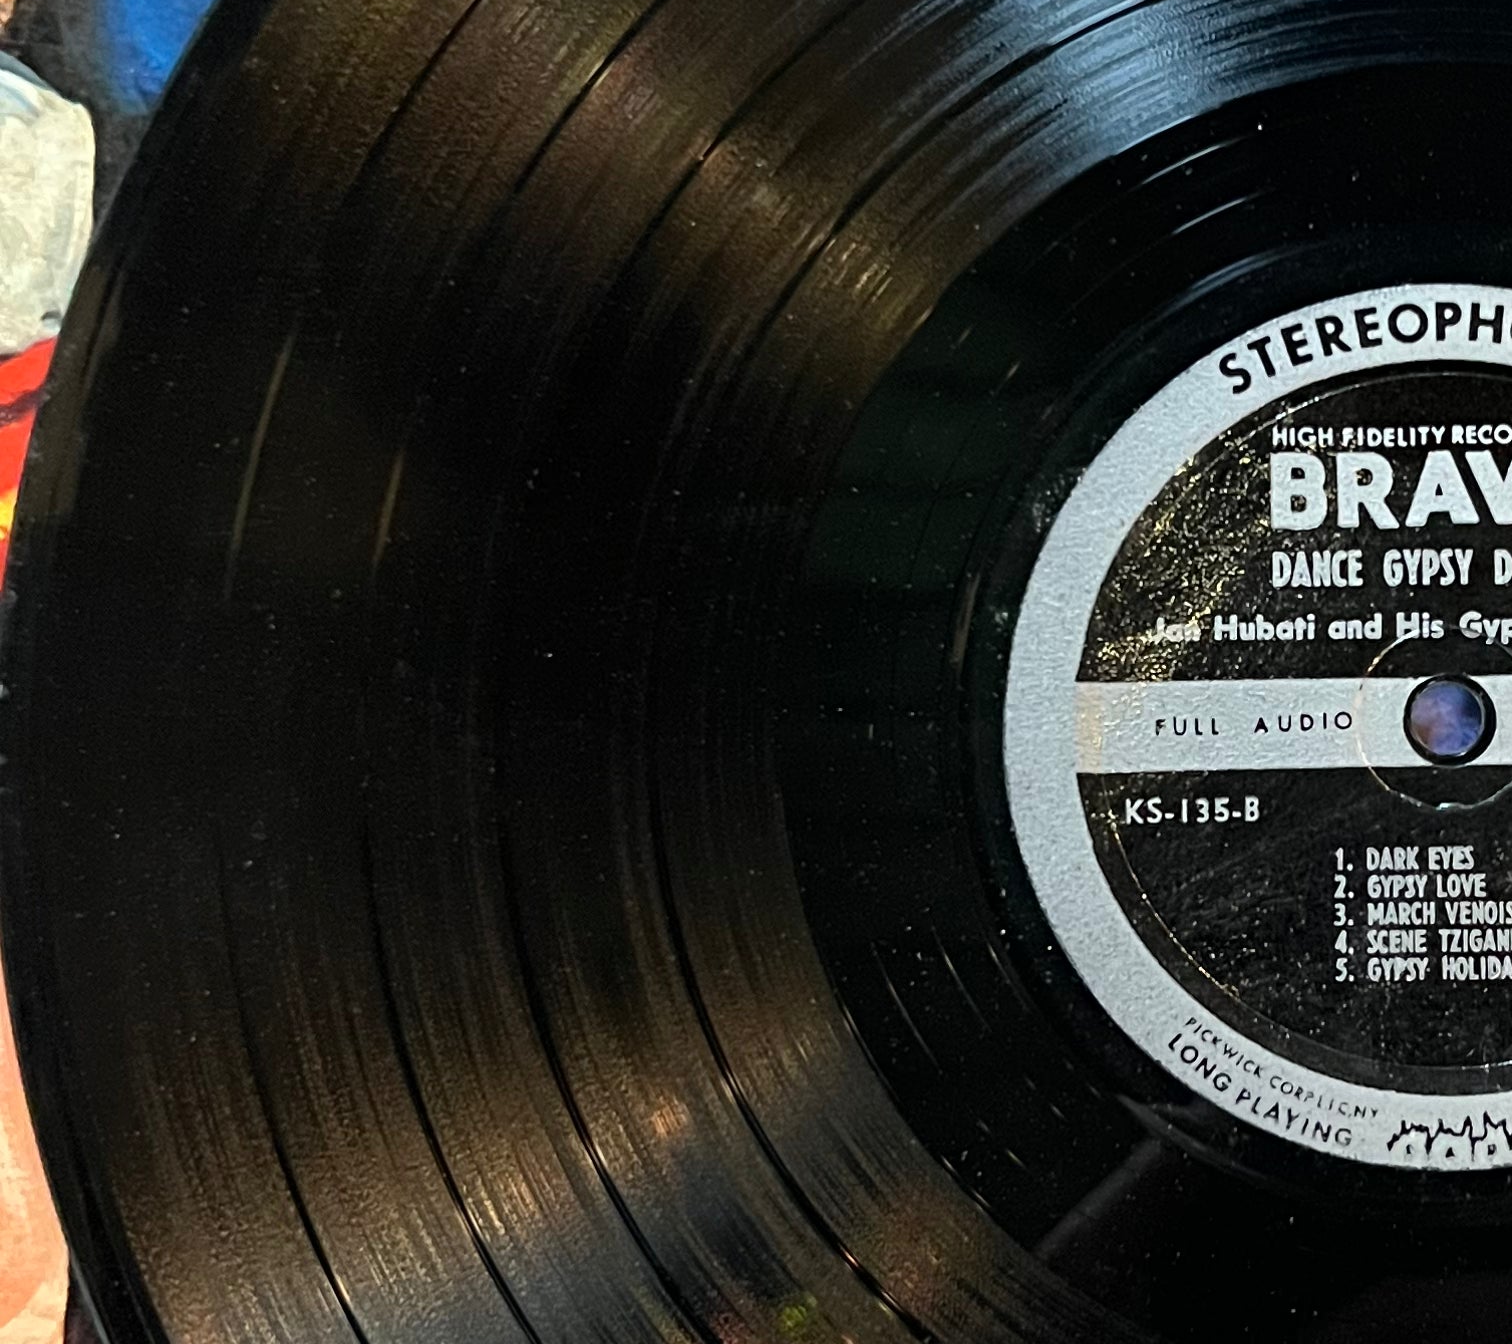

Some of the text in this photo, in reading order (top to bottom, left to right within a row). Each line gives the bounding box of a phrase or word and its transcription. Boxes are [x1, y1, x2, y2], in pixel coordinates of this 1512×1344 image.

[1272, 425, 1334, 448] HIGH
[1341, 424, 1446, 447] FIDELITY
[1272, 548, 1363, 588] DANCE
[1383, 548, 1474, 587] GYPSY
[1213, 613, 1316, 641] Hubati
[1328, 613, 1382, 639] and
[1396, 612, 1444, 639] His
[1155, 716, 1219, 736] FULL
[1254, 711, 1352, 733] AUDIO
[1125, 795, 1260, 825] KS-135-B
[1334, 845, 1474, 871] 1. DARK EYES
[1334, 873, 1487, 899] 2. GYPSY LOVE
[1333, 903, 1354, 926] 3.
[1367, 901, 1435, 926] MARCH
[1334, 930, 1354, 955] 4.
[1367, 928, 1427, 954] SCENE
[1335, 957, 1355, 982] 5.
[1367, 957, 1429, 982] GYPSY
[1185, 1017, 1264, 1078] PICKWICK
[1168, 1033, 1352, 1146] LONG PLAYING
